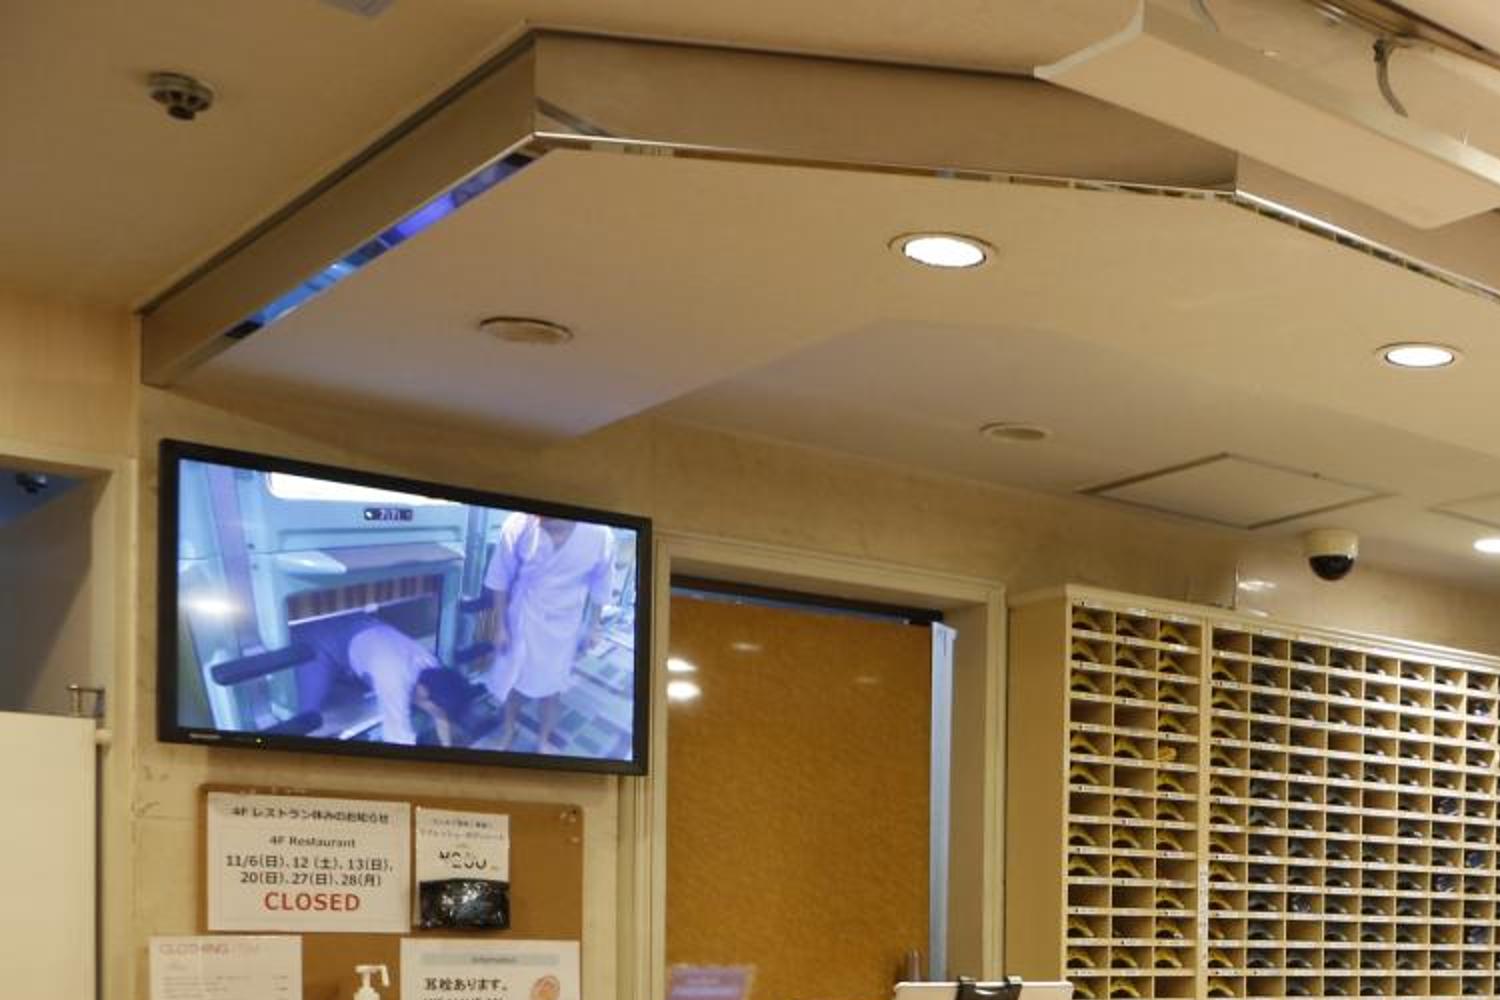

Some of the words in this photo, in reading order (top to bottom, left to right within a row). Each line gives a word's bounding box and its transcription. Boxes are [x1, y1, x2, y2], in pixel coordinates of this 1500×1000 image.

[269, 835, 286, 845] 4F
[289, 836, 356, 848] Restaurant
[263, 891, 361, 912] CLOSED
